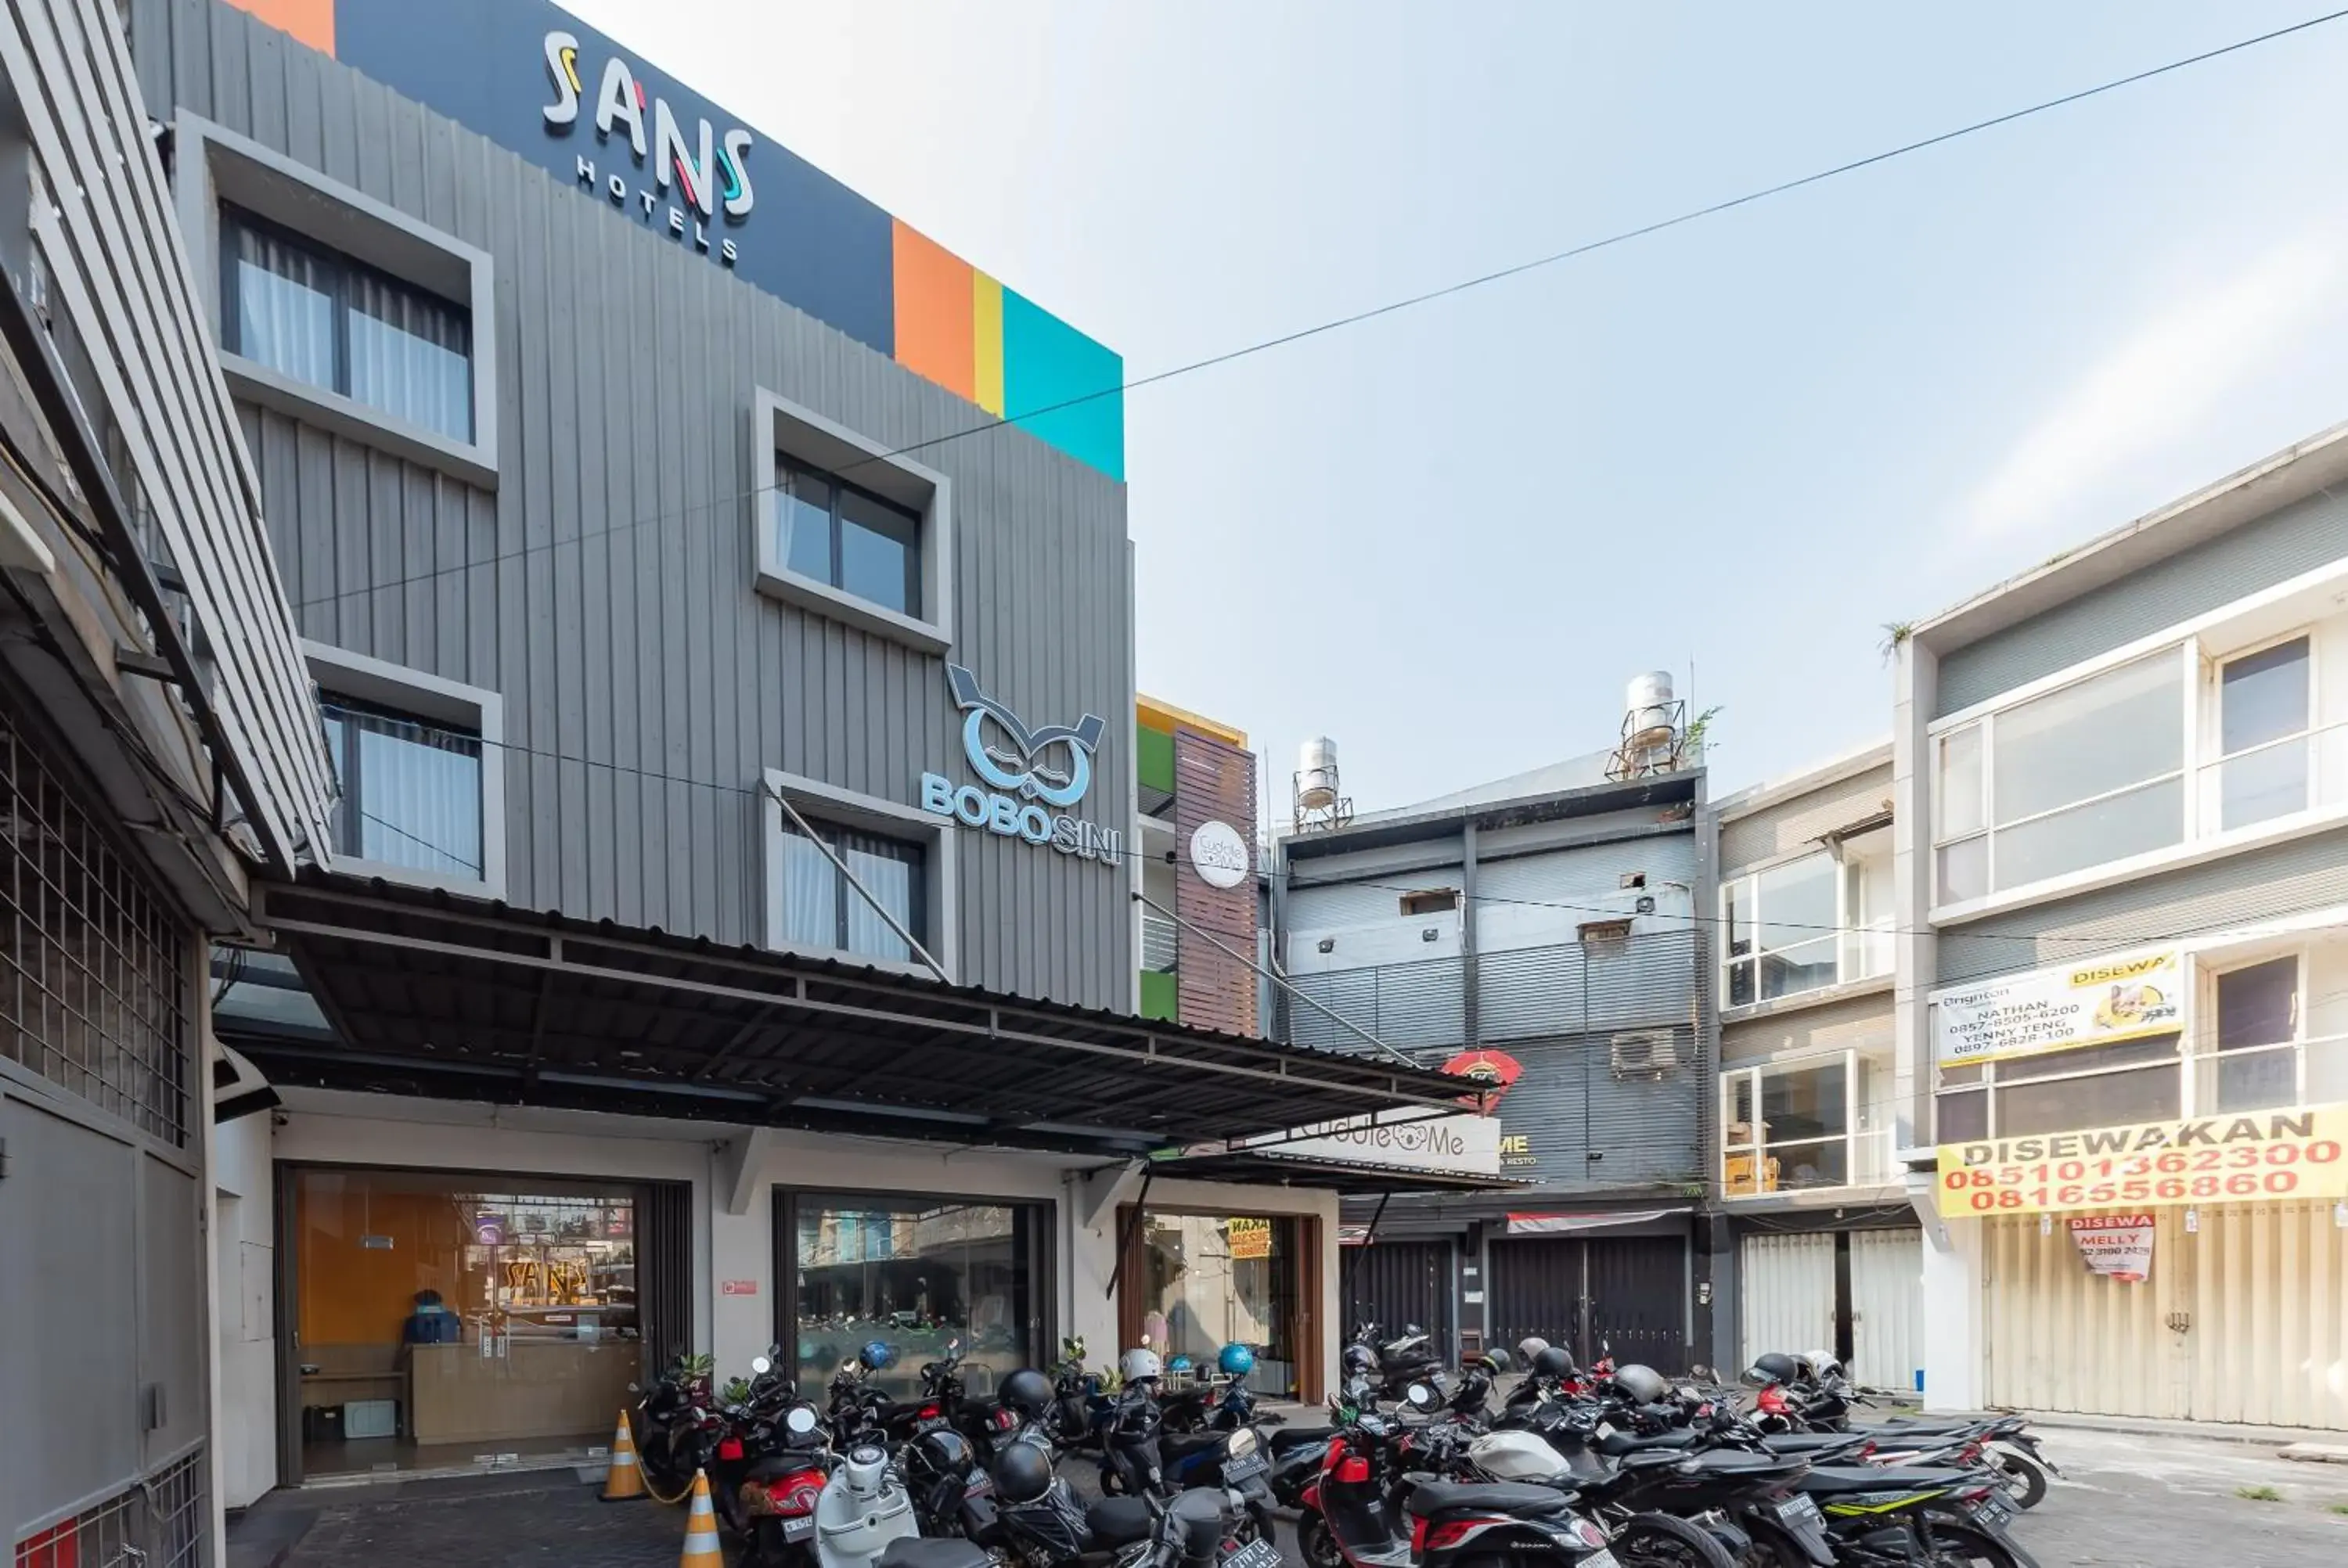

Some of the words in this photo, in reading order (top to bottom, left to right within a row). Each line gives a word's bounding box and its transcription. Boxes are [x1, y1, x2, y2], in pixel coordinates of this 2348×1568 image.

[542, 31, 754, 215] SANS
[577, 154, 738, 261] HOTELS
[921, 771, 1122, 866] BOBOSINI
[2074, 957, 2164, 984] DISEWA
[1978, 999, 2049, 1021] NATHAN
[1427, 1125, 1464, 1156] Me
[1964, 1113, 2314, 1167] DISEWAKAN
[1945, 1140, 2342, 1190] 085101362300
[1971, 1171, 2299, 1211] 0816556860
[2071, 1215, 2152, 1229] DISEWA
[2080, 1234, 2140, 1245] MELLY
